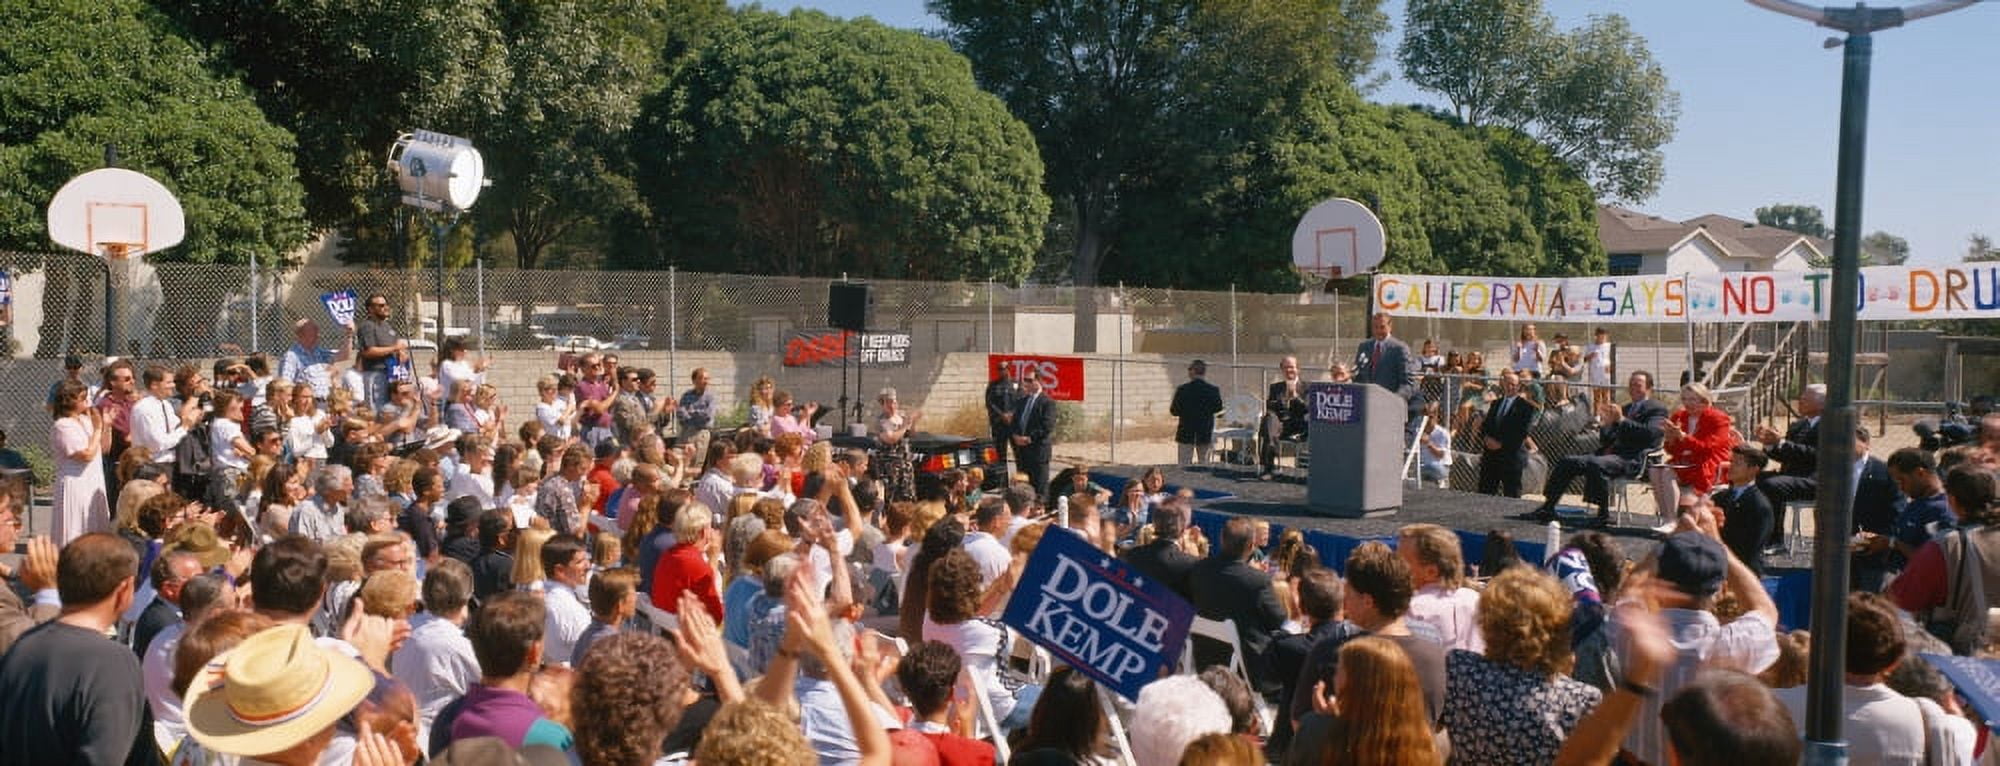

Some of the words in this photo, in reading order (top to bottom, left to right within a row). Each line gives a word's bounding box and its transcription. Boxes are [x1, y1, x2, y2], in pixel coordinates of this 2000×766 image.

[1376, 278, 1567, 317] CALIFORNIA
[1597, 279, 1684, 317] SAYS
[1722, 276, 1776, 316] NO
[1803, 271, 1865, 314] T
[1316, 391, 1353, 408] DOLE
[1316, 406, 1352, 421] KEMP
[1040, 553, 1169, 652] DOLE
[1025, 592, 1147, 683] KEMP
